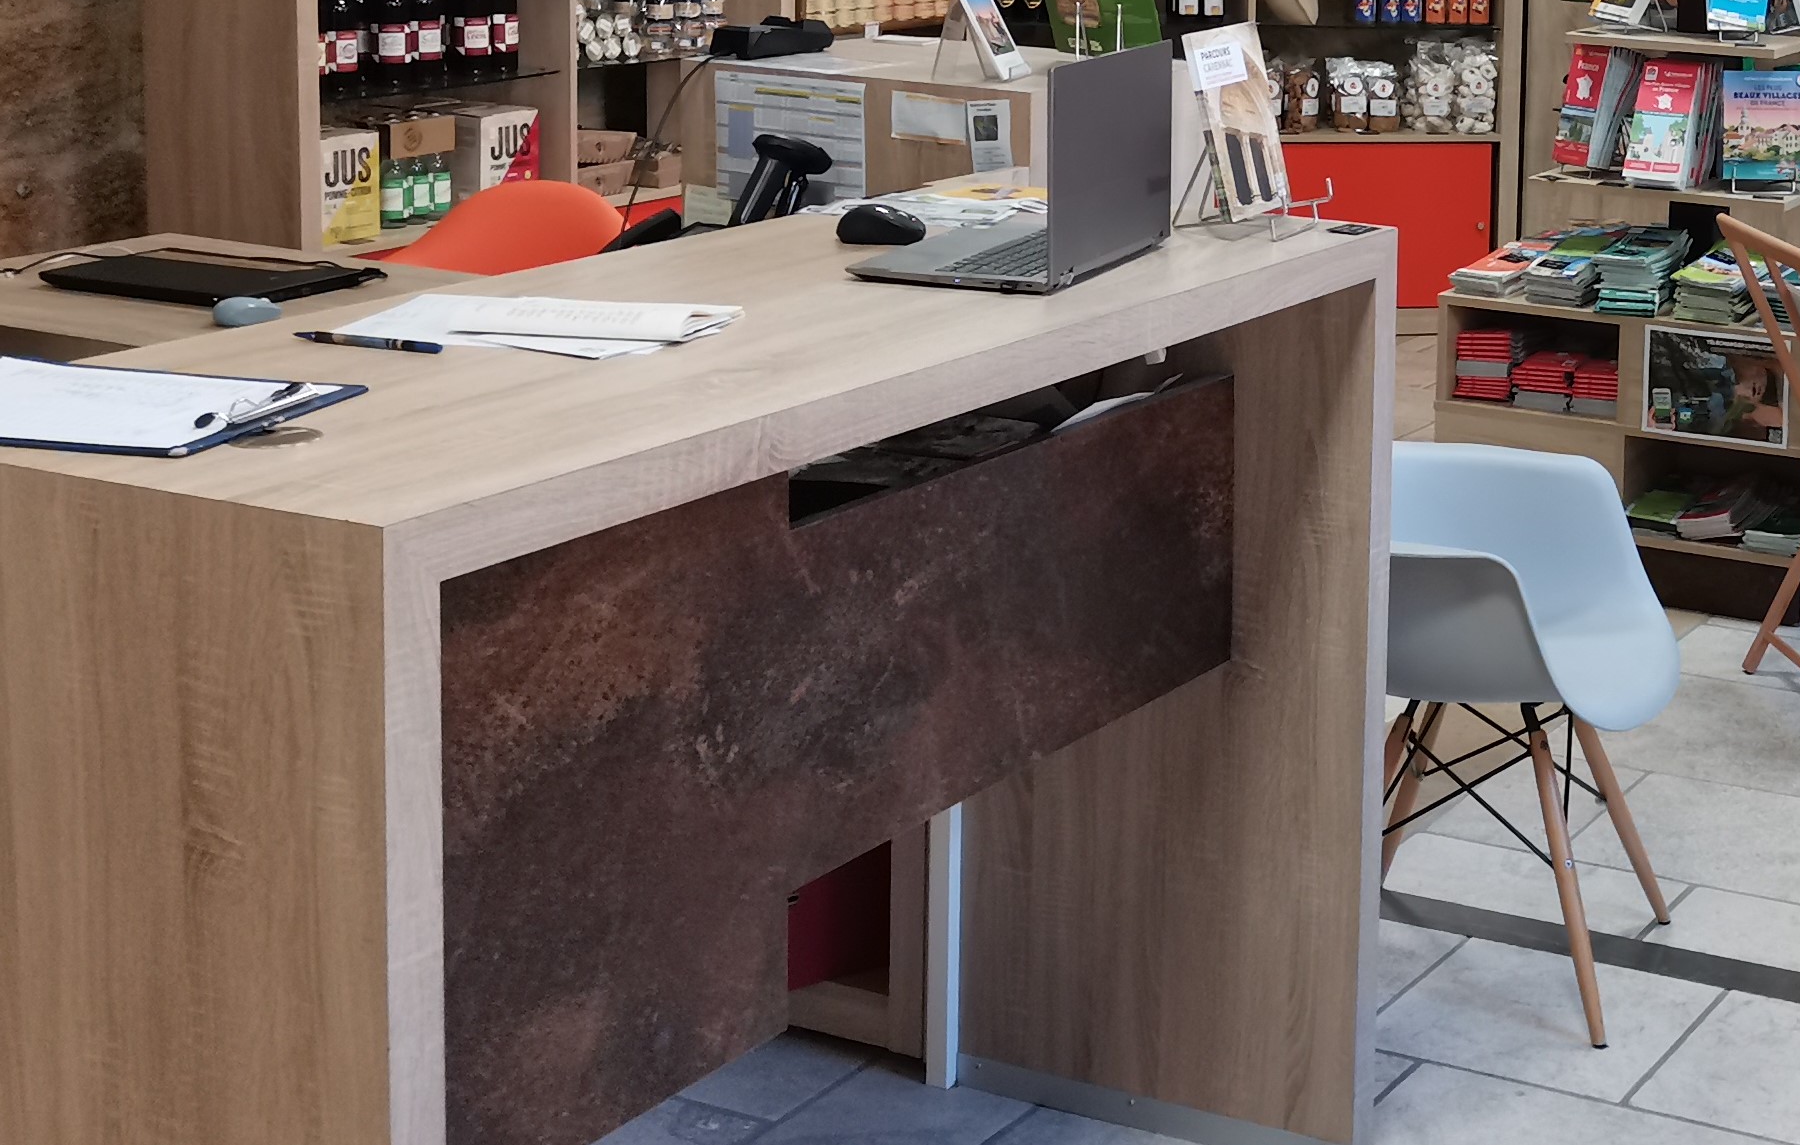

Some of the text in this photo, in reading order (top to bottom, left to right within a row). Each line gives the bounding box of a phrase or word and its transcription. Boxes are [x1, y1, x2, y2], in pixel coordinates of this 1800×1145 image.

[1733, 91, 1761, 100] BEAUX
[490, 122, 531, 161] JUS
[324, 146, 372, 188] JUS
